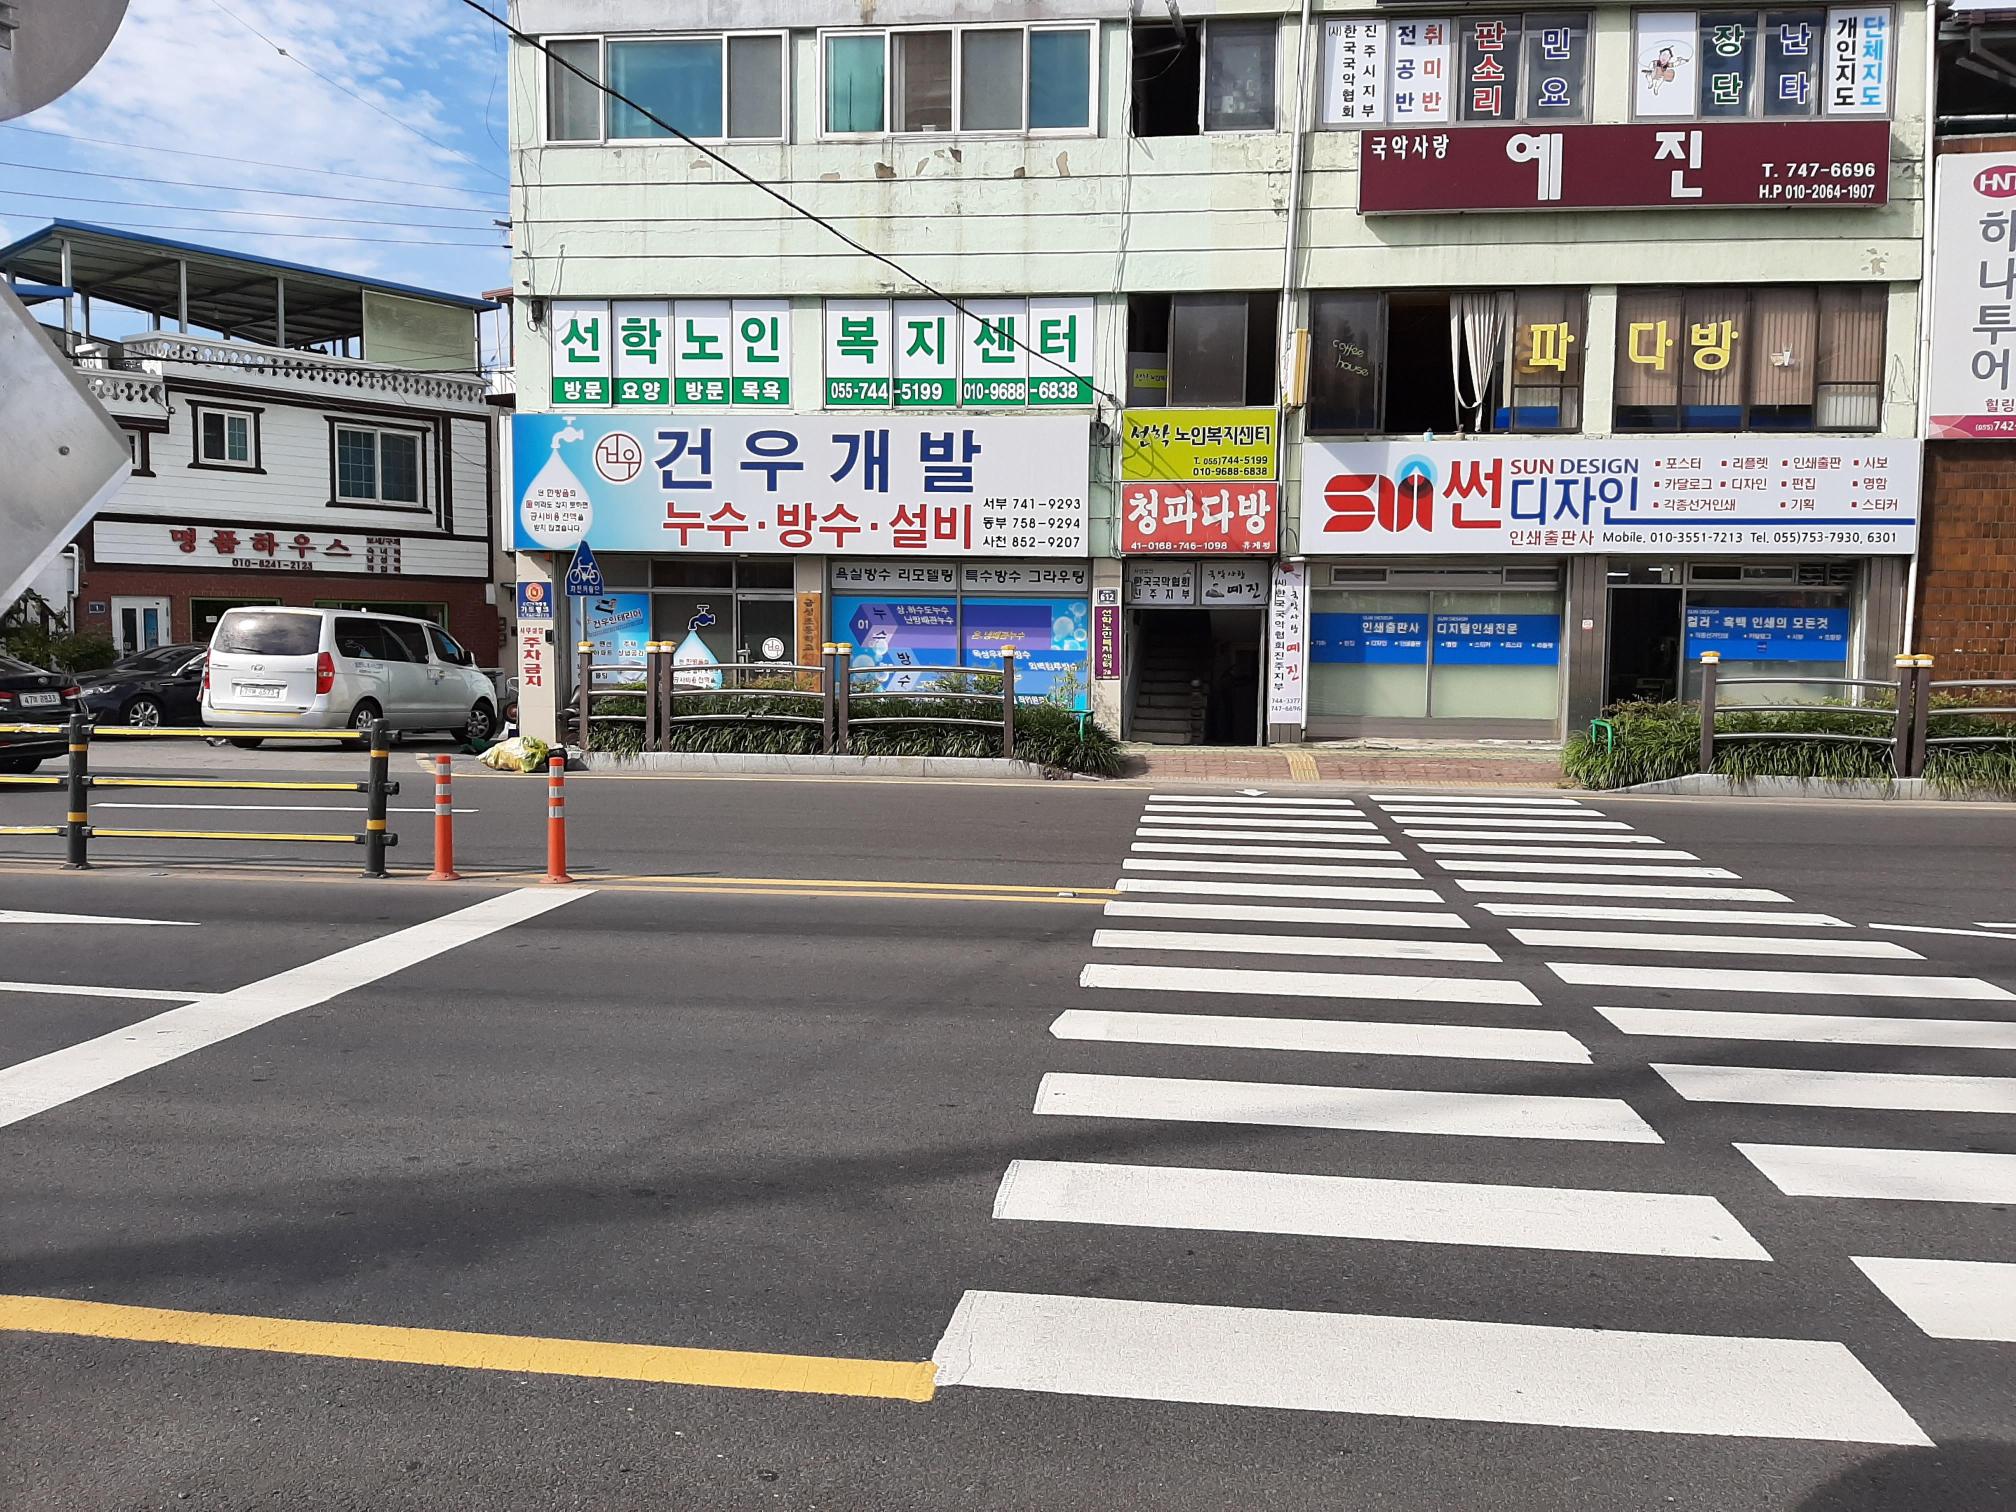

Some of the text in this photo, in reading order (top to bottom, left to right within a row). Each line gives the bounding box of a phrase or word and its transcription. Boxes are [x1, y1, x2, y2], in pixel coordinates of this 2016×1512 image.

[1396, 25, 1416, 112] 전공반
[1422, 24, 1442, 112] 취미반
[1472, 20, 1504, 116] 판소리
[1540, 27, 1571, 107] 민요
[1713, 24, 1744, 105] 장단
[1779, 23, 1811, 104] 난타
[1834, 16, 1857, 106] 개인지도
[1860, 16, 1885, 106] 단체지도
[1362, 24, 1377, 118] 진주시지부
[1371, 134, 1450, 160] 국악사랑
[1762, 163, 1876, 177] T. 747-6696
[1759, 184, 1876, 199] H.P 010-2064-1907
[1333, 340, 1364, 357] coffee
[1336, 355, 1369, 376] house
[564, 381, 781, 401] 방문 요양 방문 목욕
[1985, 399, 2014, 412] 힐링
[1131, 424, 1271, 447] 선학 노인복지센터
[655, 428, 982, 493] 건우개발
[1510, 458, 1639, 475] SUN DESIGN
[1665, 456, 1888, 470] 포스터 리플렛 인쇄출판 사보
[1193, 468, 1268, 476] 010-9688-6838
[1665, 477, 1888, 491] 카달로그 디자인 편집 명함
[983, 498, 1081, 510] 서부 741-9293
[1128, 489, 1271, 535] 청파다방
[1664, 498, 1898, 511] 각종선거인쇄 기획 스티커
[983, 517, 1080, 529] 동부 758-9294
[170, 528, 352, 558] 명품하우스
[983, 536, 1080, 548] 사천 852-9207
[1509, 530, 1594, 546] 인쇄출판사
[1602, 531, 1646, 544] Mobile.
[1650, 532, 1743, 544] 010-3551-7213
[1751, 532, 1770, 544] Tel.
[1867, 532, 1897, 544] 6301
[835, 567, 954, 582] 욕실방수 리모델링
[965, 569, 1085, 584] 특수방수 그라우팅
[858, 620, 869, 629] 01
[1362, 622, 1419, 633] 인쇄출판사
[1437, 623, 1518, 635] 디지털인쇄전문
[1687, 616, 1828, 629] 컬러 흑백 인쇄의 모든것
[523, 637, 542, 686] 주차금지
